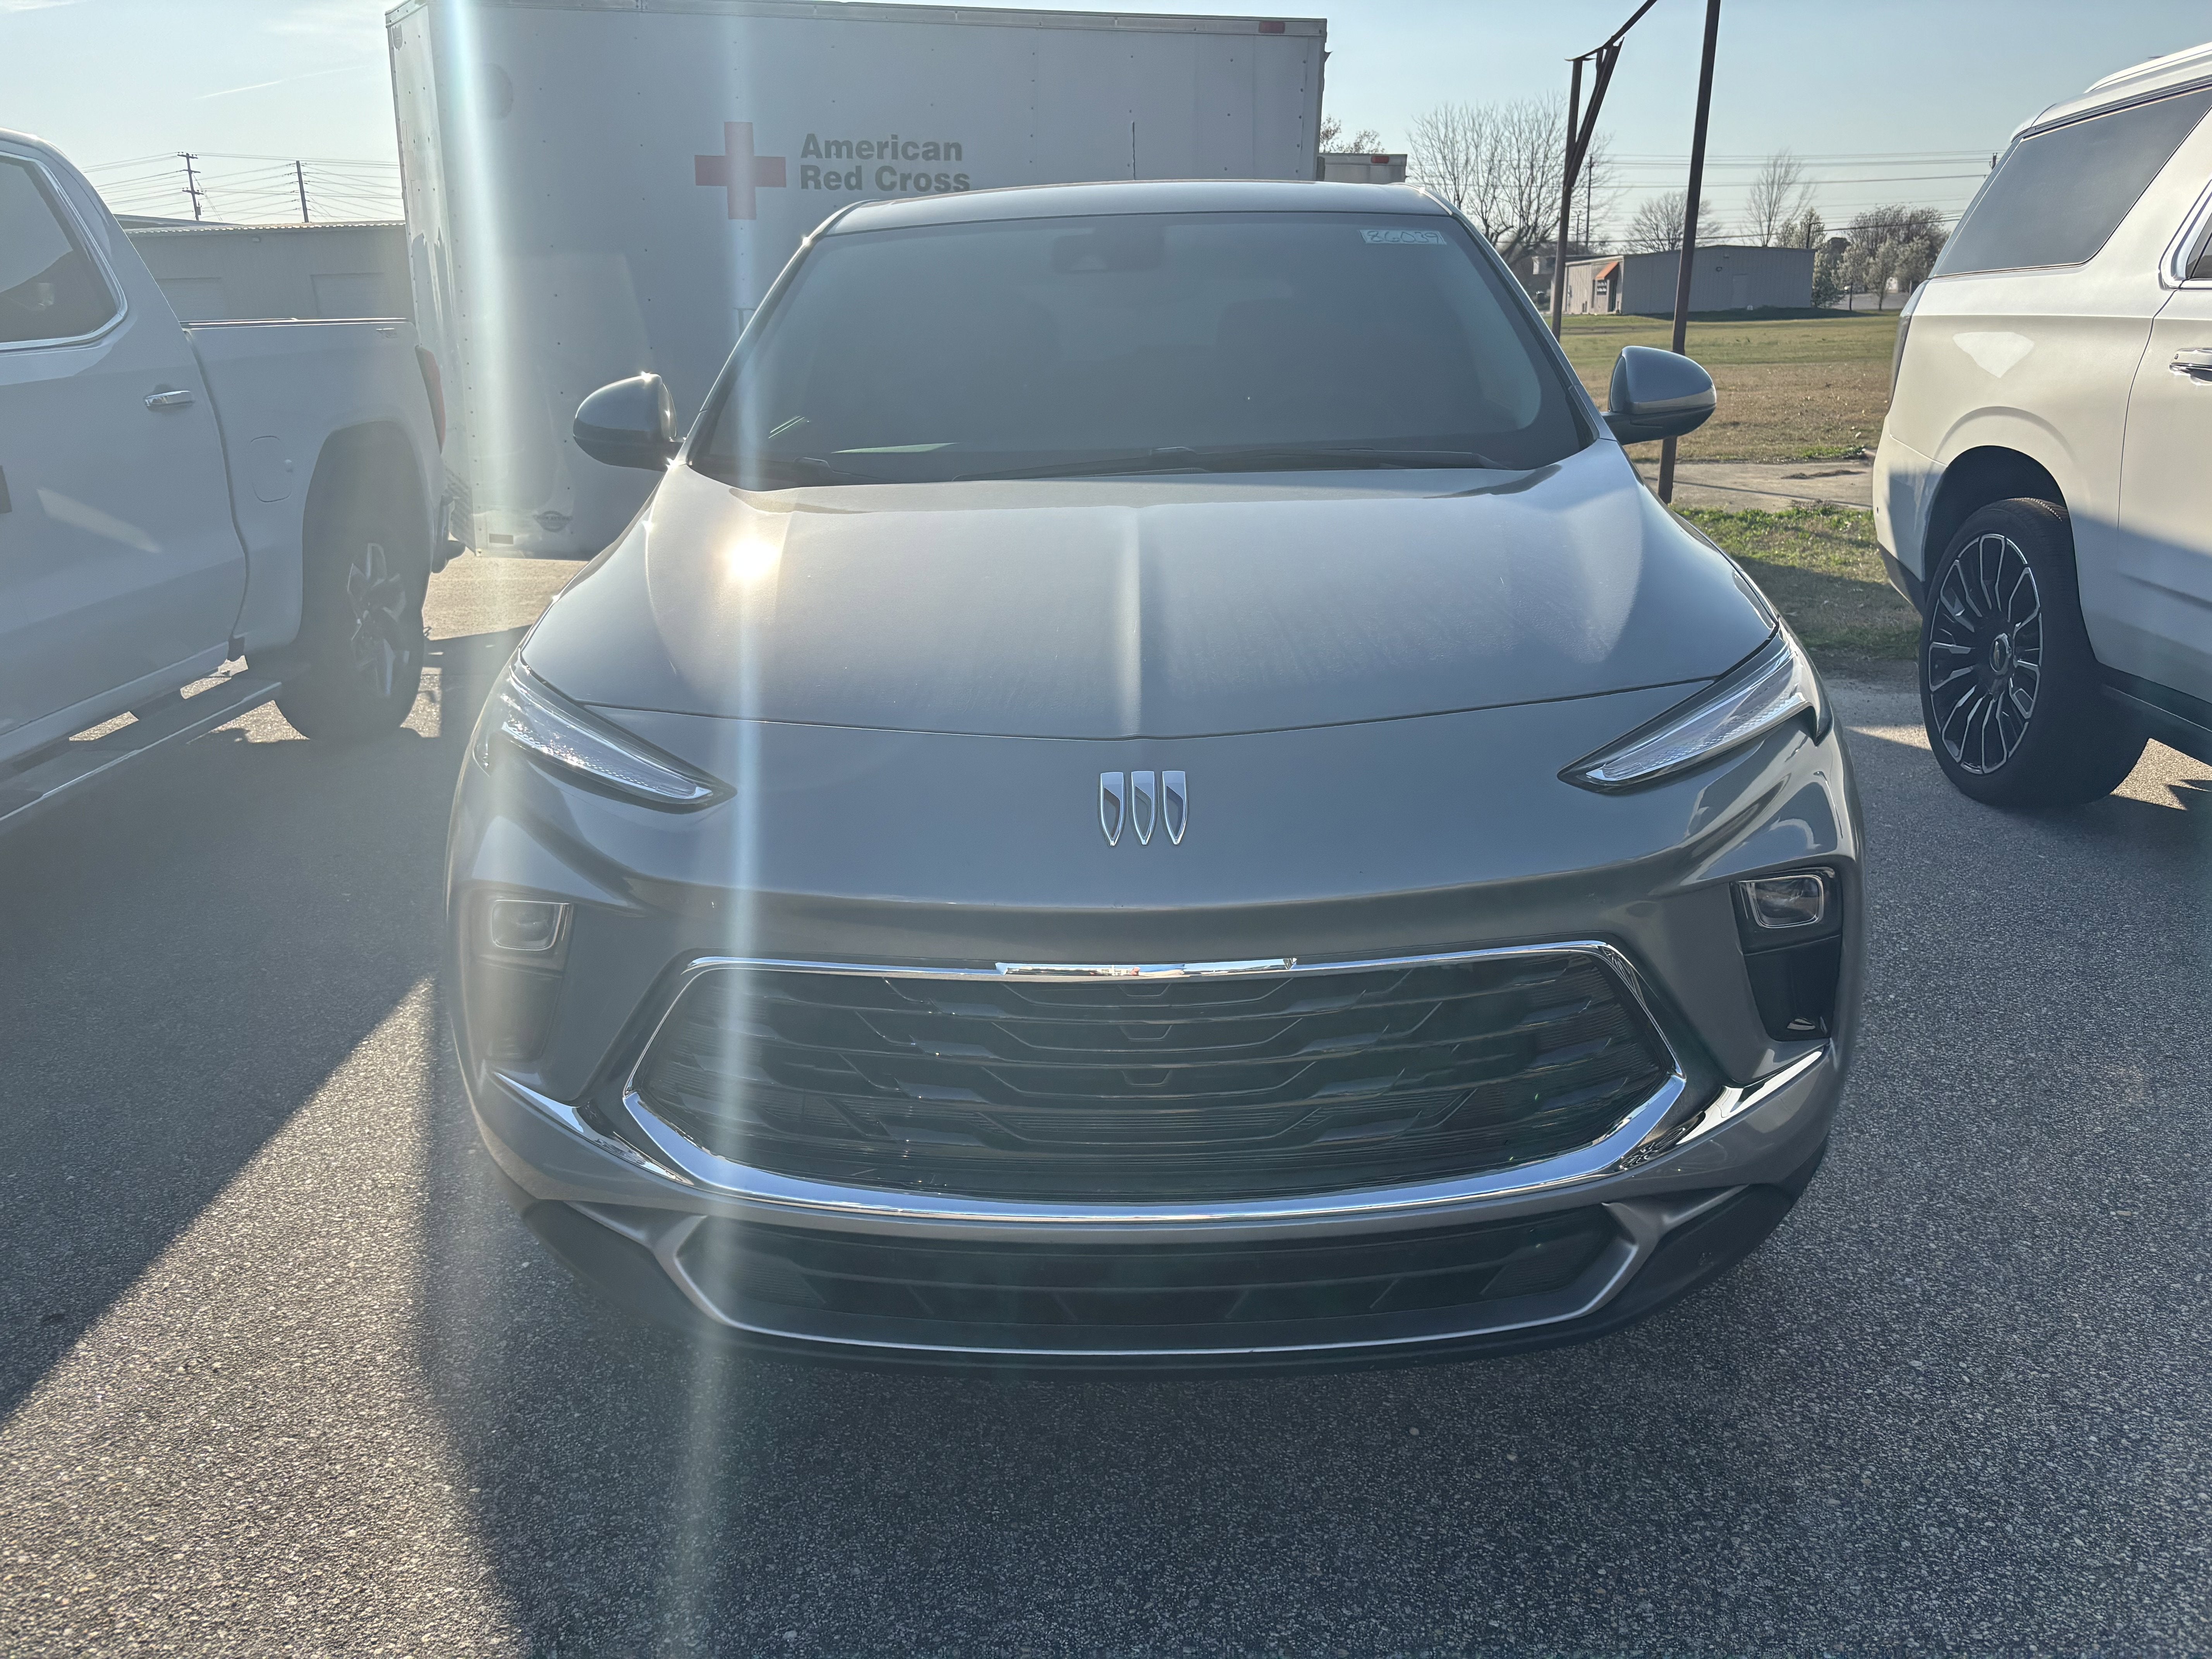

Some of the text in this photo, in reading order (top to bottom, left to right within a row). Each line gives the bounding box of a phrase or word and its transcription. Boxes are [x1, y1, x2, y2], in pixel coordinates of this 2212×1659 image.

[800, 133, 963, 162] American
[800, 165, 970, 192] Red Cross
